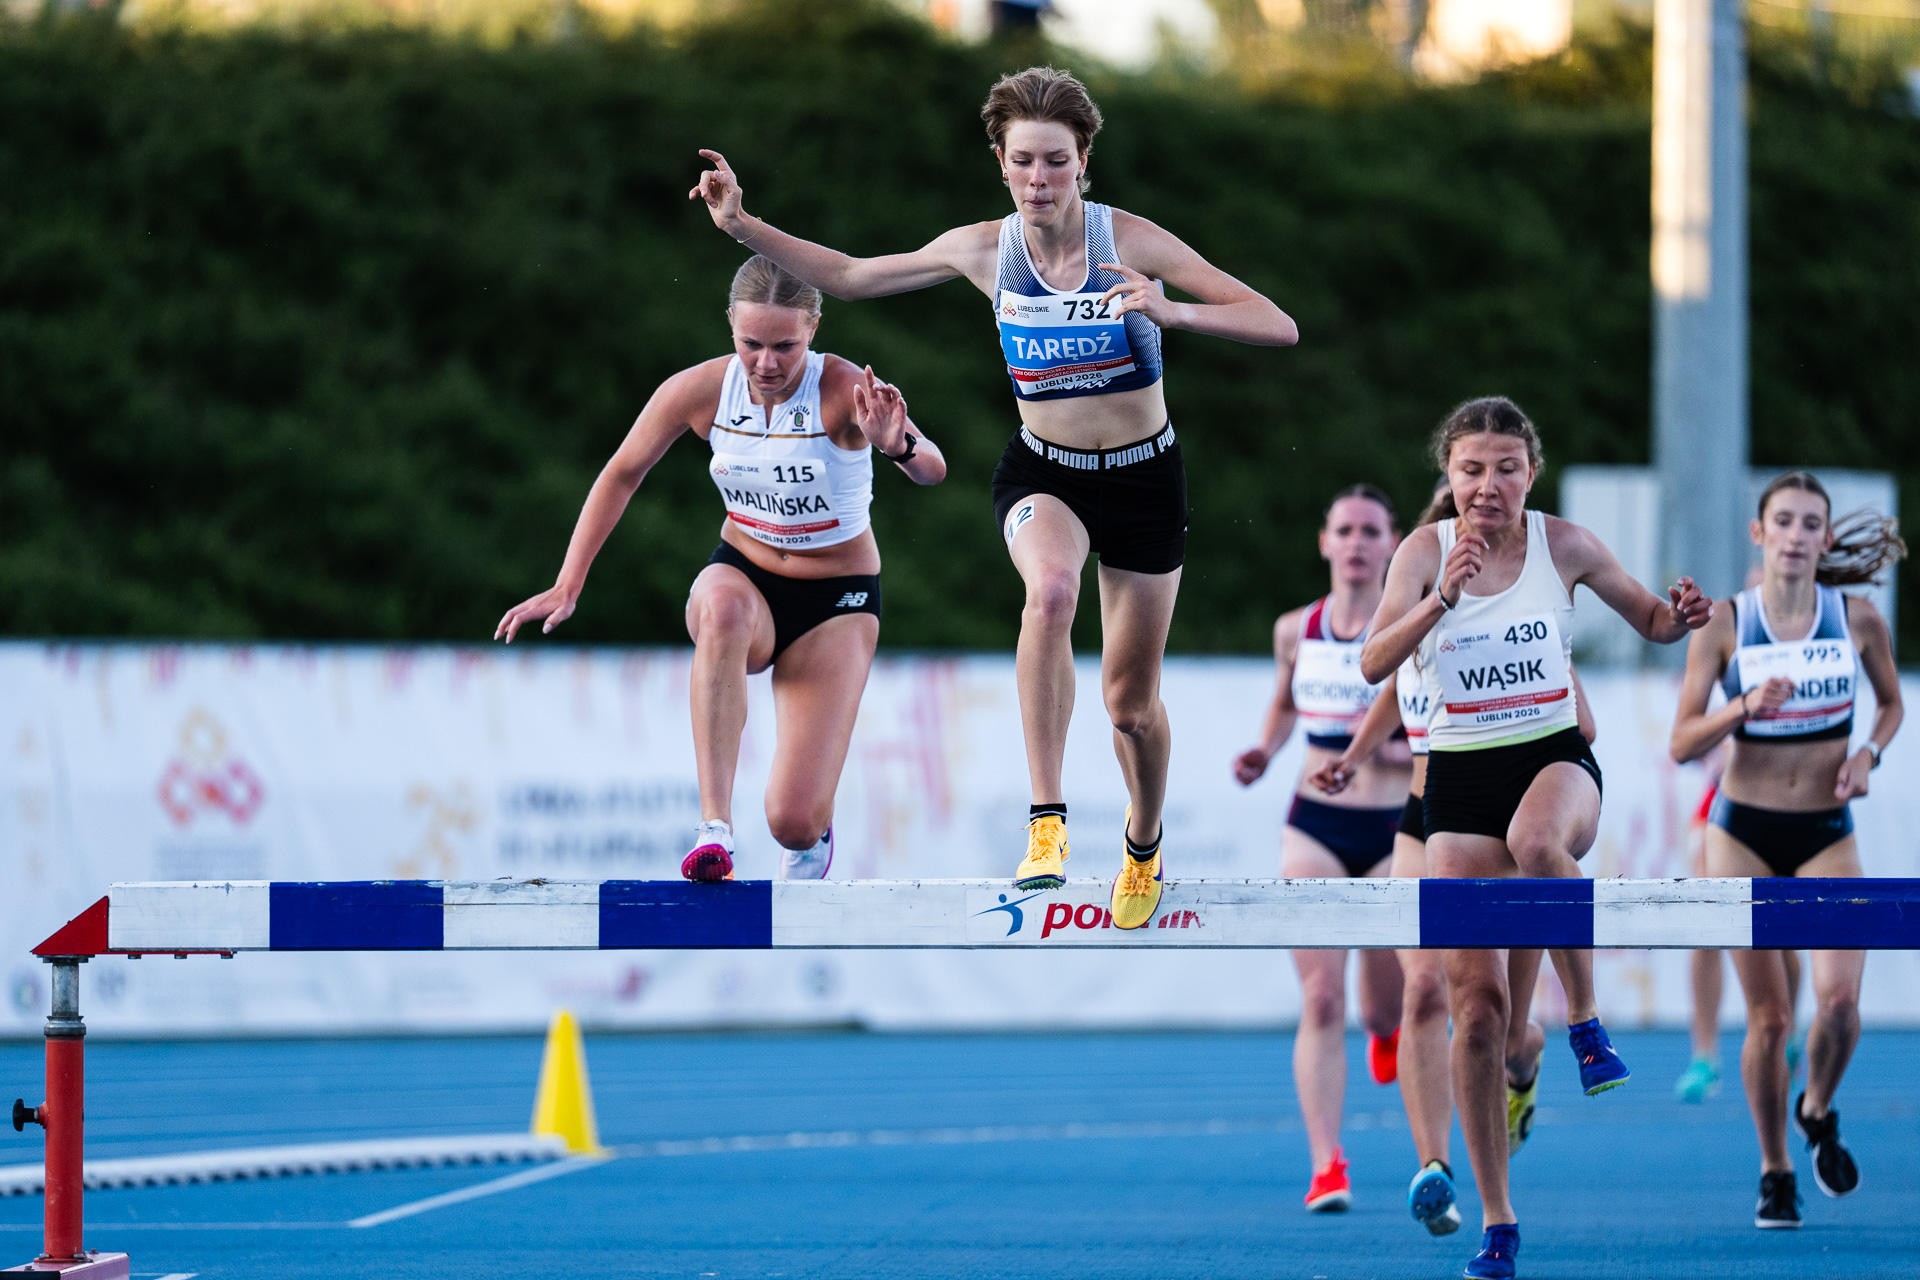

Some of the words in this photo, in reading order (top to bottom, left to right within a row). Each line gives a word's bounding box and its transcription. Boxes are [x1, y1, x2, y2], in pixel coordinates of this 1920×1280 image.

[1017, 304, 1050, 313] LUBELSKIE
[1063, 299, 1111, 321] 732
[1011, 332, 1115, 361] TARĘDŹ
[1035, 376, 1073, 390] LUBLIN
[1075, 372, 1102, 382] 2026
[1048, 446, 1099, 470] PUMA
[1105, 441, 1155, 470] PUMA
[773, 465, 815, 483] 115
[724, 487, 830, 516] MALIŃSKA
[754, 531, 783, 543] LUBLIN
[785, 536, 812, 544] 2026
[1504, 621, 1547, 645] 430
[1803, 645, 1841, 661] 995
[1458, 658, 1545, 691] WĄSIK
[1476, 711, 1512, 723] LUBLIN
[1514, 707, 1540, 718] 2026
